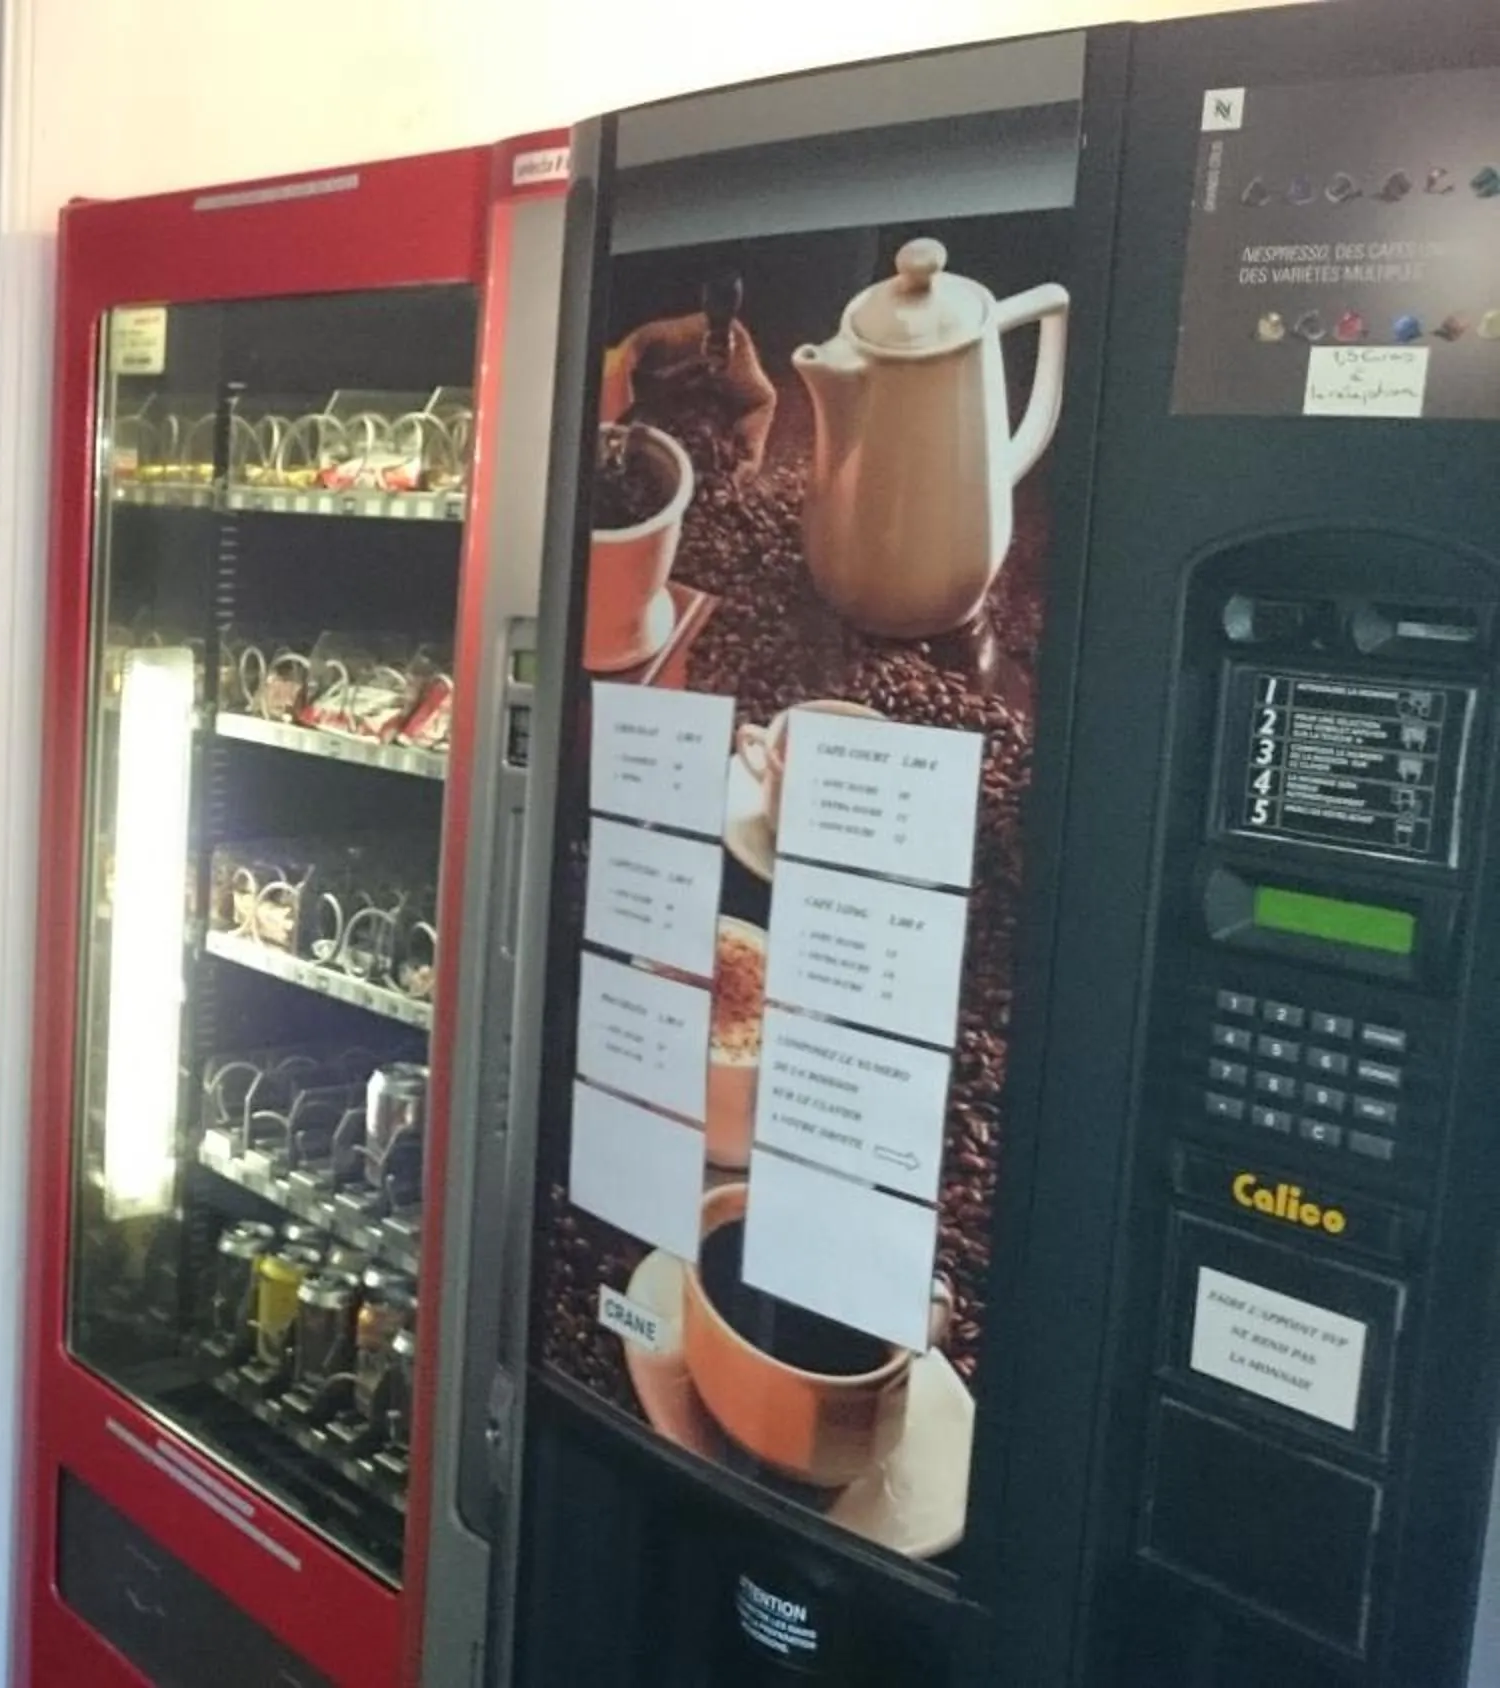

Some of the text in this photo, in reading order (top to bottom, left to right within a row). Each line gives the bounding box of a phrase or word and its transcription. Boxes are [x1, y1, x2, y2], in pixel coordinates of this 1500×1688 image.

[1239, 267, 1268, 284] DES
[1265, 678, 1276, 704] 1
[1259, 709, 1276, 736] 2
[1255, 739, 1275, 765] 3
[1253, 769, 1271, 795] 4
[1251, 799, 1269, 825] 5
[1231, 1172, 1348, 1235] Calico
[605, 1298, 656, 1341] CRANE
[1230, 1325, 1317, 1365] NE REND PAS
[1228, 1351, 1314, 1391] LA MONNAIE
